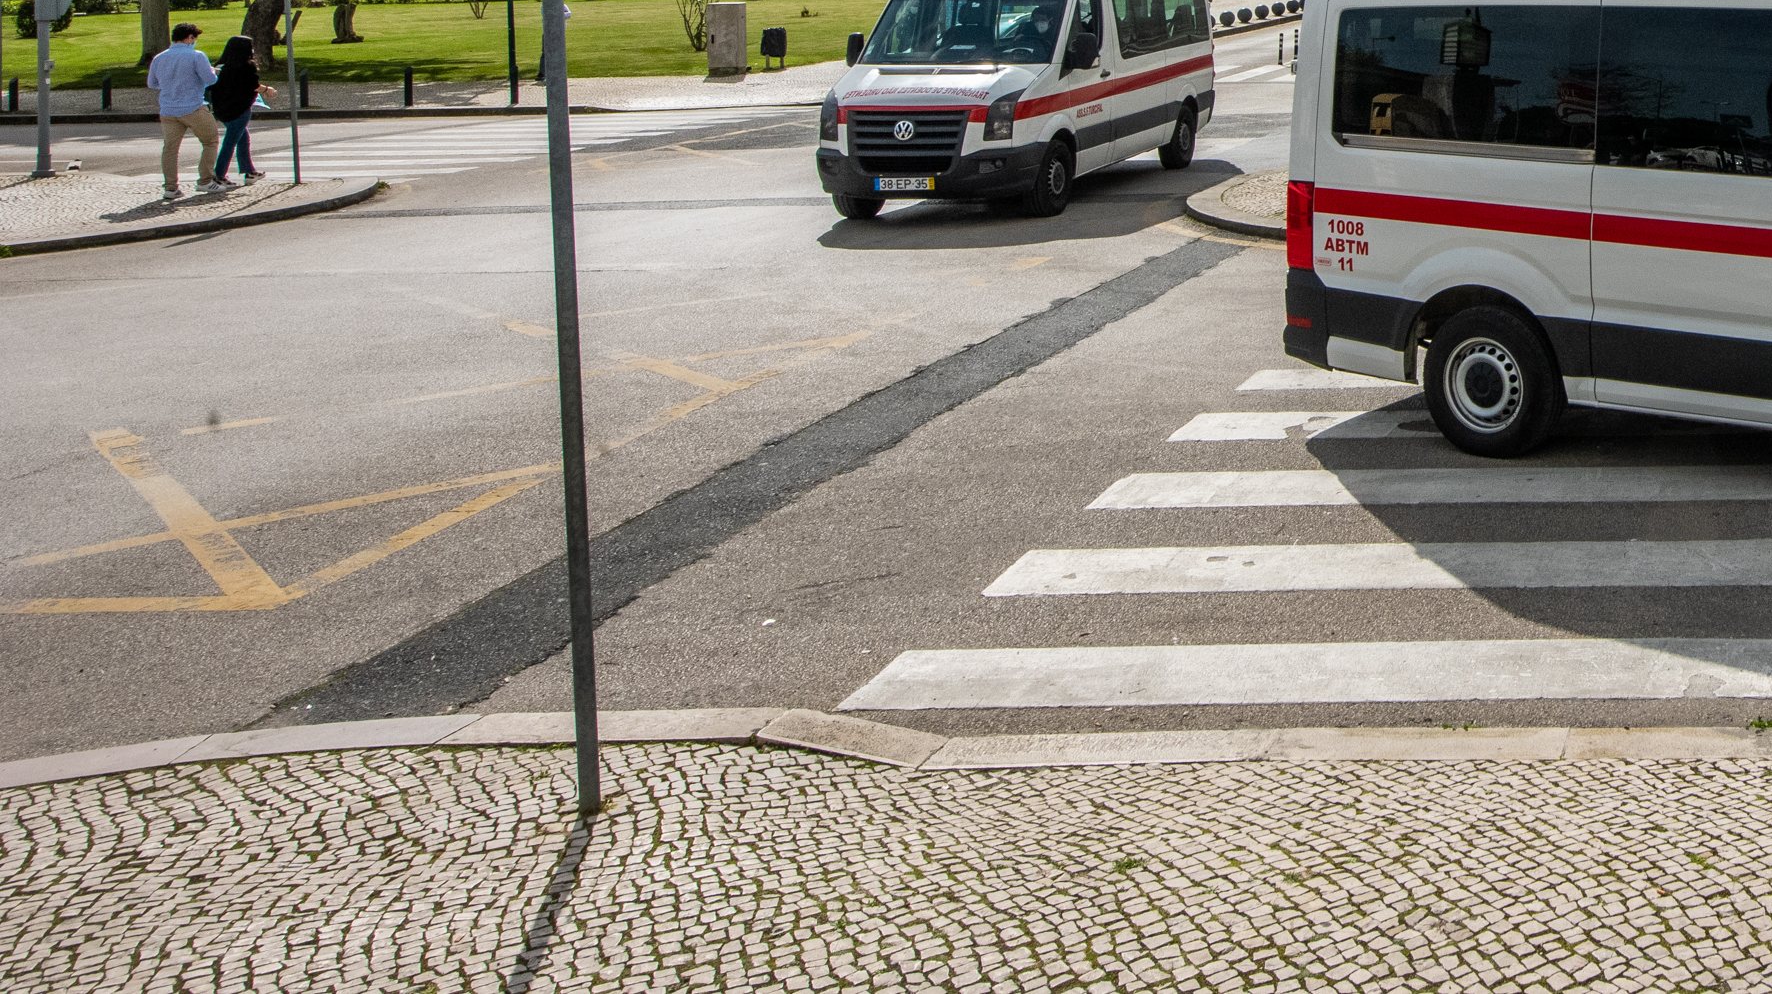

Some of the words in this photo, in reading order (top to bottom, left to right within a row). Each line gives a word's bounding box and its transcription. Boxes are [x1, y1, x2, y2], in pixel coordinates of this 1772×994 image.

[1328, 218, 1365, 237] 1008
[1324, 237, 1369, 256] ABTM
[1337, 256, 1354, 272] 11
